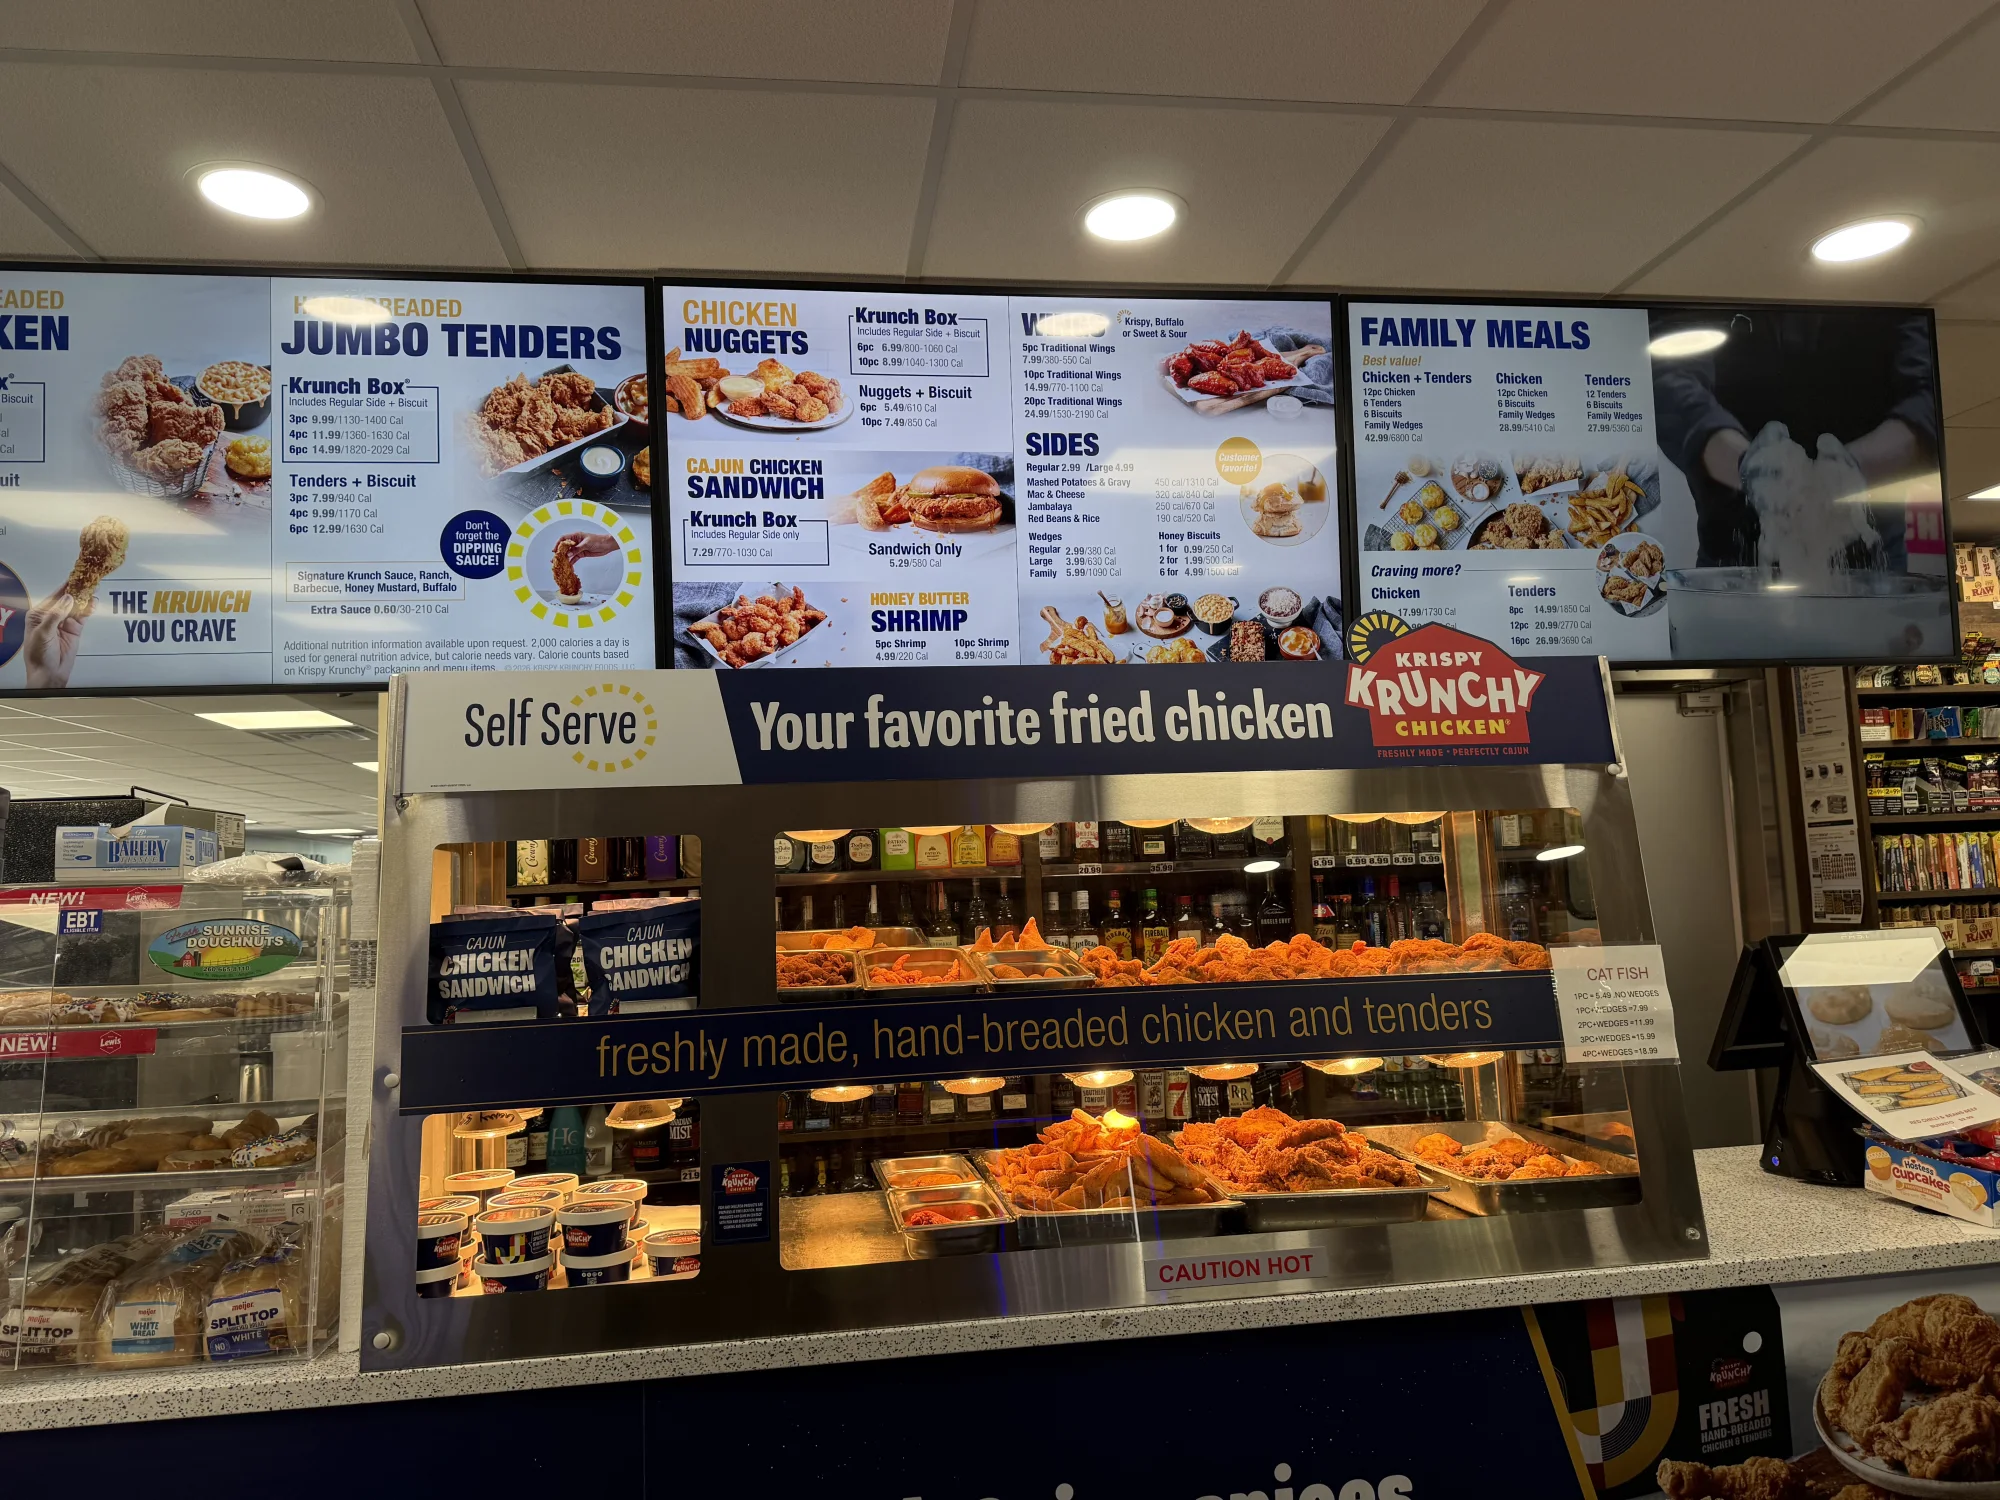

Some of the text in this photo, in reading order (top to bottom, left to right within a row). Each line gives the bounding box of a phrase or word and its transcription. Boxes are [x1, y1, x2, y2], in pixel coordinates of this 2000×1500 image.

[683, 300, 797, 326] CHICKEN
[856, 308, 958, 326] Krunch Box
[1125, 317, 1184, 327] Krispy, Buffalo
[280, 320, 622, 360] JUMBO TENDERS
[1133, 328, 1157, 338] Sweet
[1160, 330, 1166, 338] &
[1168, 329, 1187, 338] Sour
[1360, 317, 1590, 350] FAMILY MEALS
[686, 328, 808, 355] NUGGETS
[1022, 344, 1115, 354] 5pc Traditional Wings
[1022, 356, 1092, 364] 7.99/380-550 Cal
[1363, 355, 1422, 366] Best value!
[1363, 372, 1410, 383] Chicken
[1424, 372, 1472, 384] Tenders
[859, 385, 972, 400] Nuggets + Biscuit
[289, 414, 404, 425] 3pc 9.99/1130-1400 Cal
[1026, 432, 1099, 456] SIDES
[1364, 434, 1423, 442] 42.99/6800 Cal
[1219, 453, 1259, 462] Customer
[687, 458, 822, 475] CAJUN CHICKEN
[1027, 463, 1134, 473] Regular 2.99 /Large 4.99
[1222, 463, 1257, 472] favorite!
[688, 476, 824, 499] SANDWICH
[466, 520, 490, 530] Don't
[455, 531, 499, 542] forget the
[454, 544, 502, 554] DIPPING
[869, 543, 962, 557] Sandwich Only
[456, 555, 498, 566] SAUCE!
[298, 570, 452, 582] Signature Krunch Sauce, Ranch,
[1372, 564, 1461, 578] Craving more?
[1972, 586, 1994, 596] RAW
[109, 590, 251, 614] THE KRUNCH
[870, 592, 970, 606] HONEY BUTTER
[872, 610, 967, 632] SHRIMP
[124, 619, 236, 642] YOU CRAVE
[284, 640, 328, 650] Additional
[331, 640, 368, 650] nutrition
[371, 640, 422, 649] information
[425, 639, 464, 649] available
[467, 641, 488, 650] upon
[492, 640, 528, 650] request.
[531, 638, 556, 649] 2,000
[560, 638, 594, 647] calories
[604, 638, 619, 649] day
[622, 638, 630, 647] is
[1511, 636, 1592, 646] 16pc 26.99/3690 Cal
[1395, 652, 1482, 668] KRISPY
[1349, 667, 1540, 716] KRUNCHY
[464, 698, 636, 748] Self Serve
[750, 688, 1334, 751] Your favorite fried chicken
[1378, 747, 1529, 758] FRESHLY MADE PERFECTLY CAJUN
[107, 838, 168, 863] BAKERY
[1314, 859, 1333, 867] 8.99
[1347, 858, 1366, 866] 8.99
[1420, 855, 1440, 864] 8.99
[1079, 865, 1101, 874] 20.99
[1150, 864, 1172, 873] 35.99
[29, 892, 148, 906] NEW! Lewis
[66, 912, 98, 927] EBT
[202, 925, 270, 936] SUNRISE
[626, 924, 664, 942] CAJUN
[1144, 929, 1168, 938] FIREBALL
[1966, 930, 1992, 942] RAW
[187, 936, 283, 948] DOUGHNUTS
[466, 935, 506, 950] CAJUN
[600, 938, 692, 970] CHICKEN
[440, 948, 535, 976] CHICKEN
[1587, 967, 1648, 980] CAT FISH
[438, 974, 536, 999] SANDWICH
[1627, 990, 1660, 998] WEDGES
[1578, 1020, 1628, 1028] 2PC+WEDGES
[596, 992, 1492, 1080] freshly made, hand-breaded chicken and tenders
[1580, 1034, 1630, 1044] 3PC+WEDGES
[0, 1036, 121, 1052] NEW! Lewis
[1582, 1048, 1634, 1058] 4PC+WEDGES
[670, 1125, 692, 1139] MIST
[1904, 1160, 1934, 1175] Hostess
[1892, 1167, 1950, 1194] Cupcakes
[1158, 1254, 1314, 1284] CAUTION HOT
[210, 1308, 278, 1330] SPLIT TOP
[130, 1322, 159, 1331] WHITE
[232, 1330, 262, 1342] WHITE
[1700, 1389, 1770, 1430] FRESH
[1701, 1416, 1771, 1443] HAND-BREADED
[1702, 1438, 1734, 1454] CHICKEN
[1742, 1428, 1772, 1443] TENDERS
